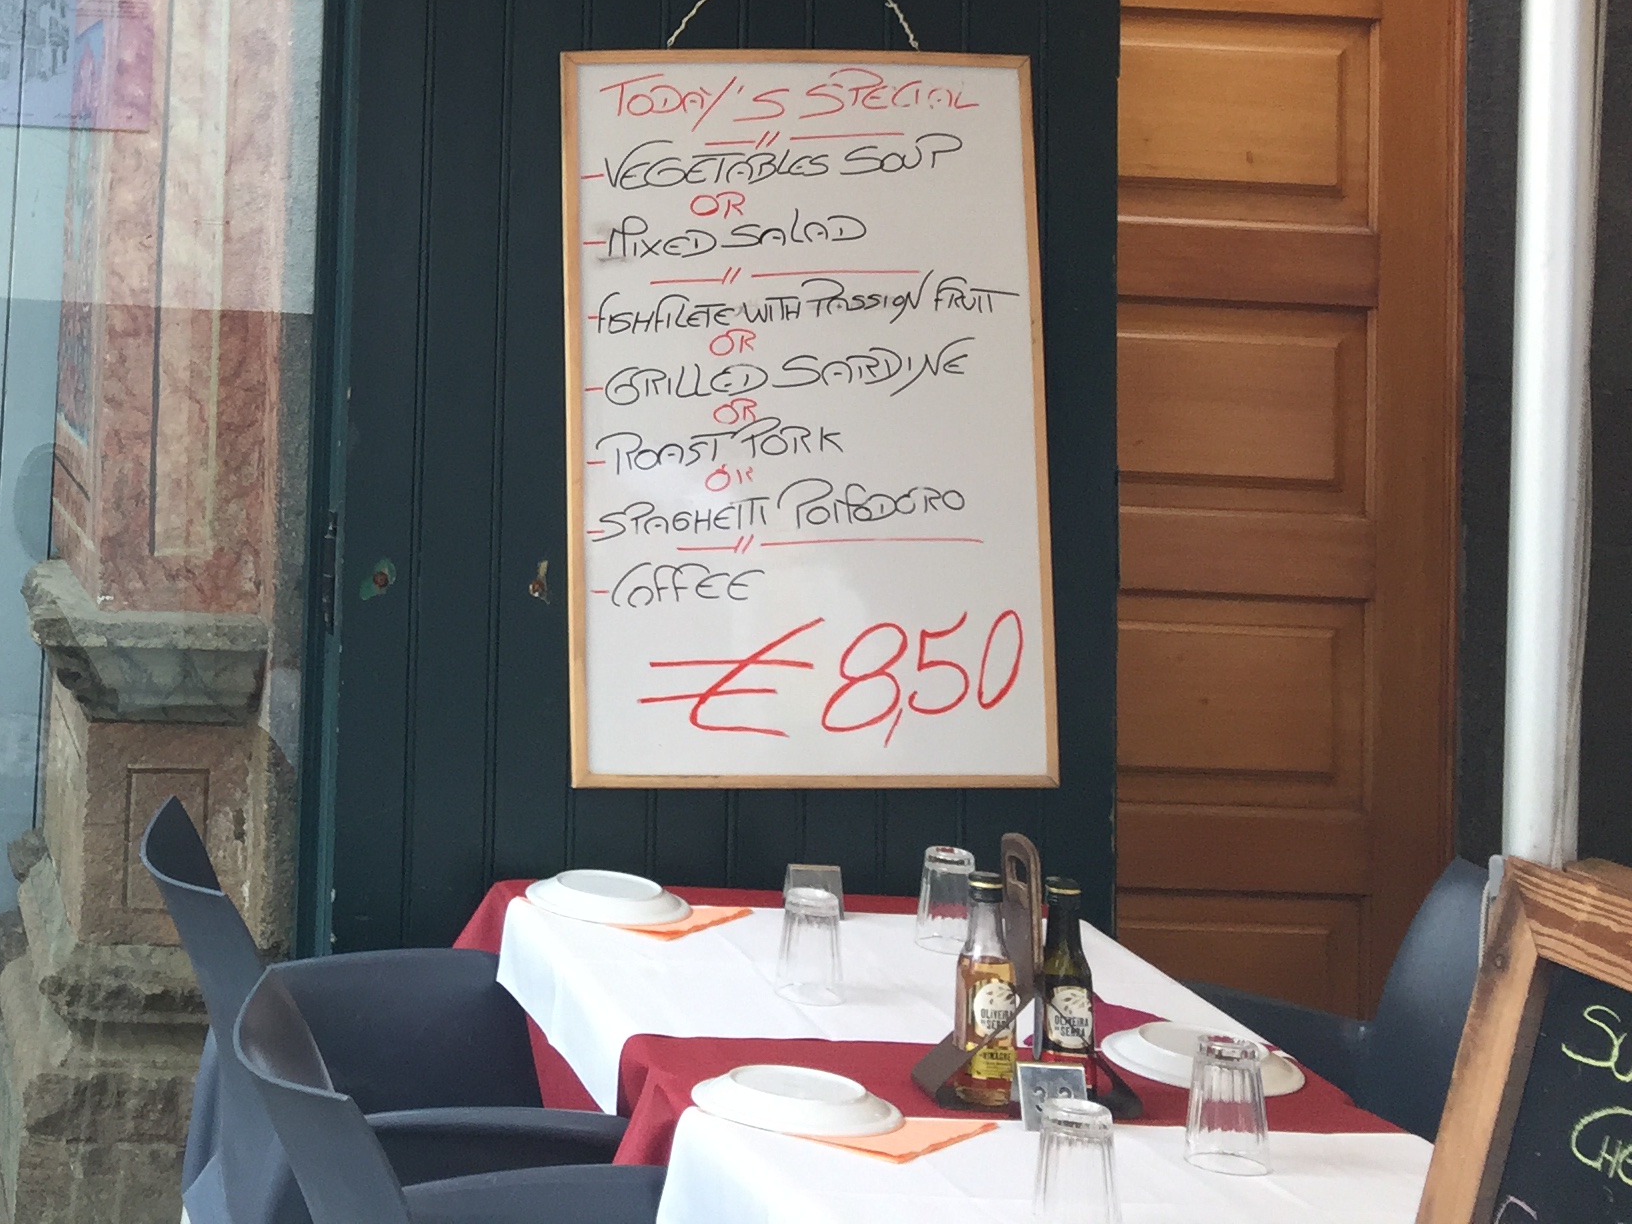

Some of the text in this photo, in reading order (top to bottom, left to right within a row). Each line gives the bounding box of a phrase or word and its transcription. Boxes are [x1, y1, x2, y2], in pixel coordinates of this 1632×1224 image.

[599, 66, 980, 133] TODAY'S SPECIAL
[603, 132, 964, 191] VEGETABLES SOUP
[689, 191, 746, 219] OR
[608, 208, 867, 259] MIXED SALAD
[741, 295, 802, 325] WITH
[801, 269, 935, 325] PASSION
[933, 275, 1021, 314] FRUIT
[708, 327, 757, 357] OR
[604, 336, 976, 406] GRILLED SARDINE
[712, 397, 758, 425] OR
[595, 416, 844, 476] ROAST PORK
[704, 464, 755, 493] OR
[591, 496, 771, 543] SPAGHETTI
[610, 561, 766, 609] COFFEE
